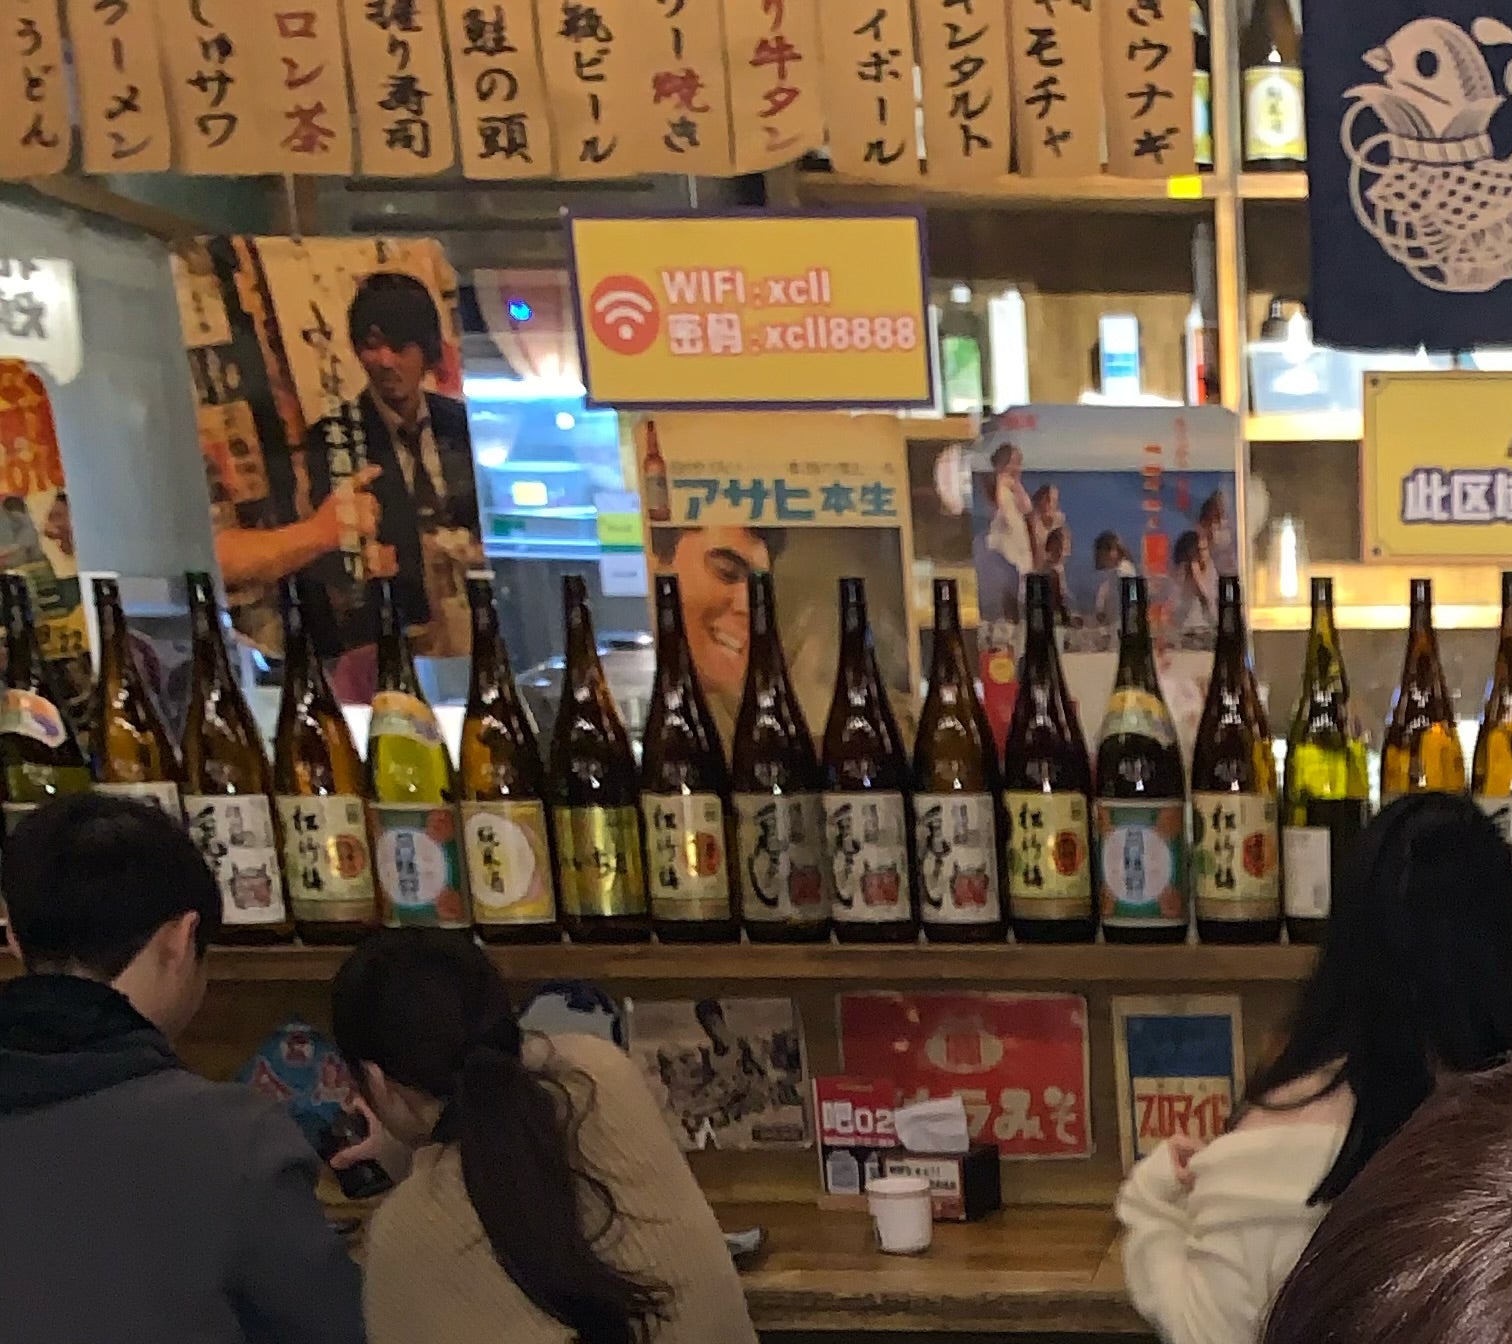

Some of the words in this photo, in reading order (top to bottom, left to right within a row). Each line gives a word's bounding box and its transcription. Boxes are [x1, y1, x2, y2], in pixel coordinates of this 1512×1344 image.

[274, 11, 337, 152] ロン茶
[463, 4, 533, 164] 鮭の頭
[853, 8, 904, 166] イボール
